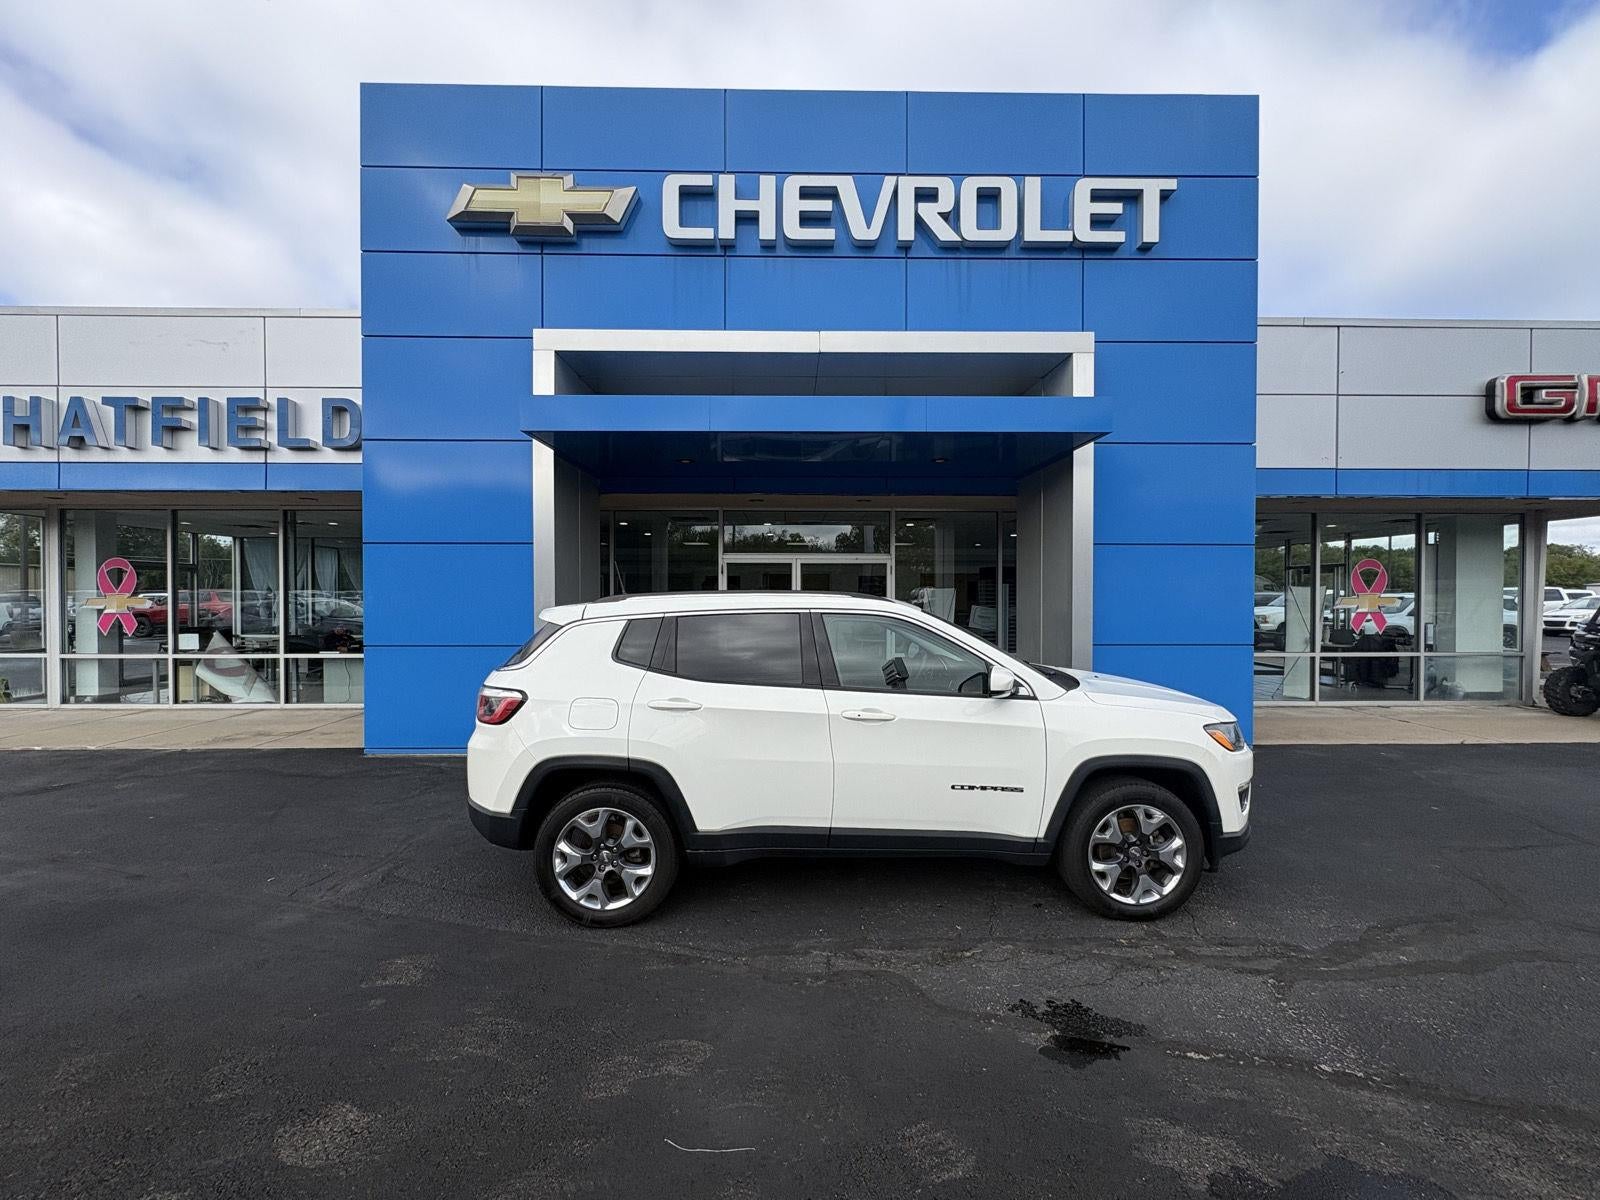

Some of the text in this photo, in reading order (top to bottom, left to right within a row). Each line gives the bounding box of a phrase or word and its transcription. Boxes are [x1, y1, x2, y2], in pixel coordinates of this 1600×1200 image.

[661, 173, 1178, 247] CHEVROLET
[1494, 372, 1600, 419] G
[2, 395, 362, 450] HATFIELD
[950, 784, 1024, 793] COMPASS
